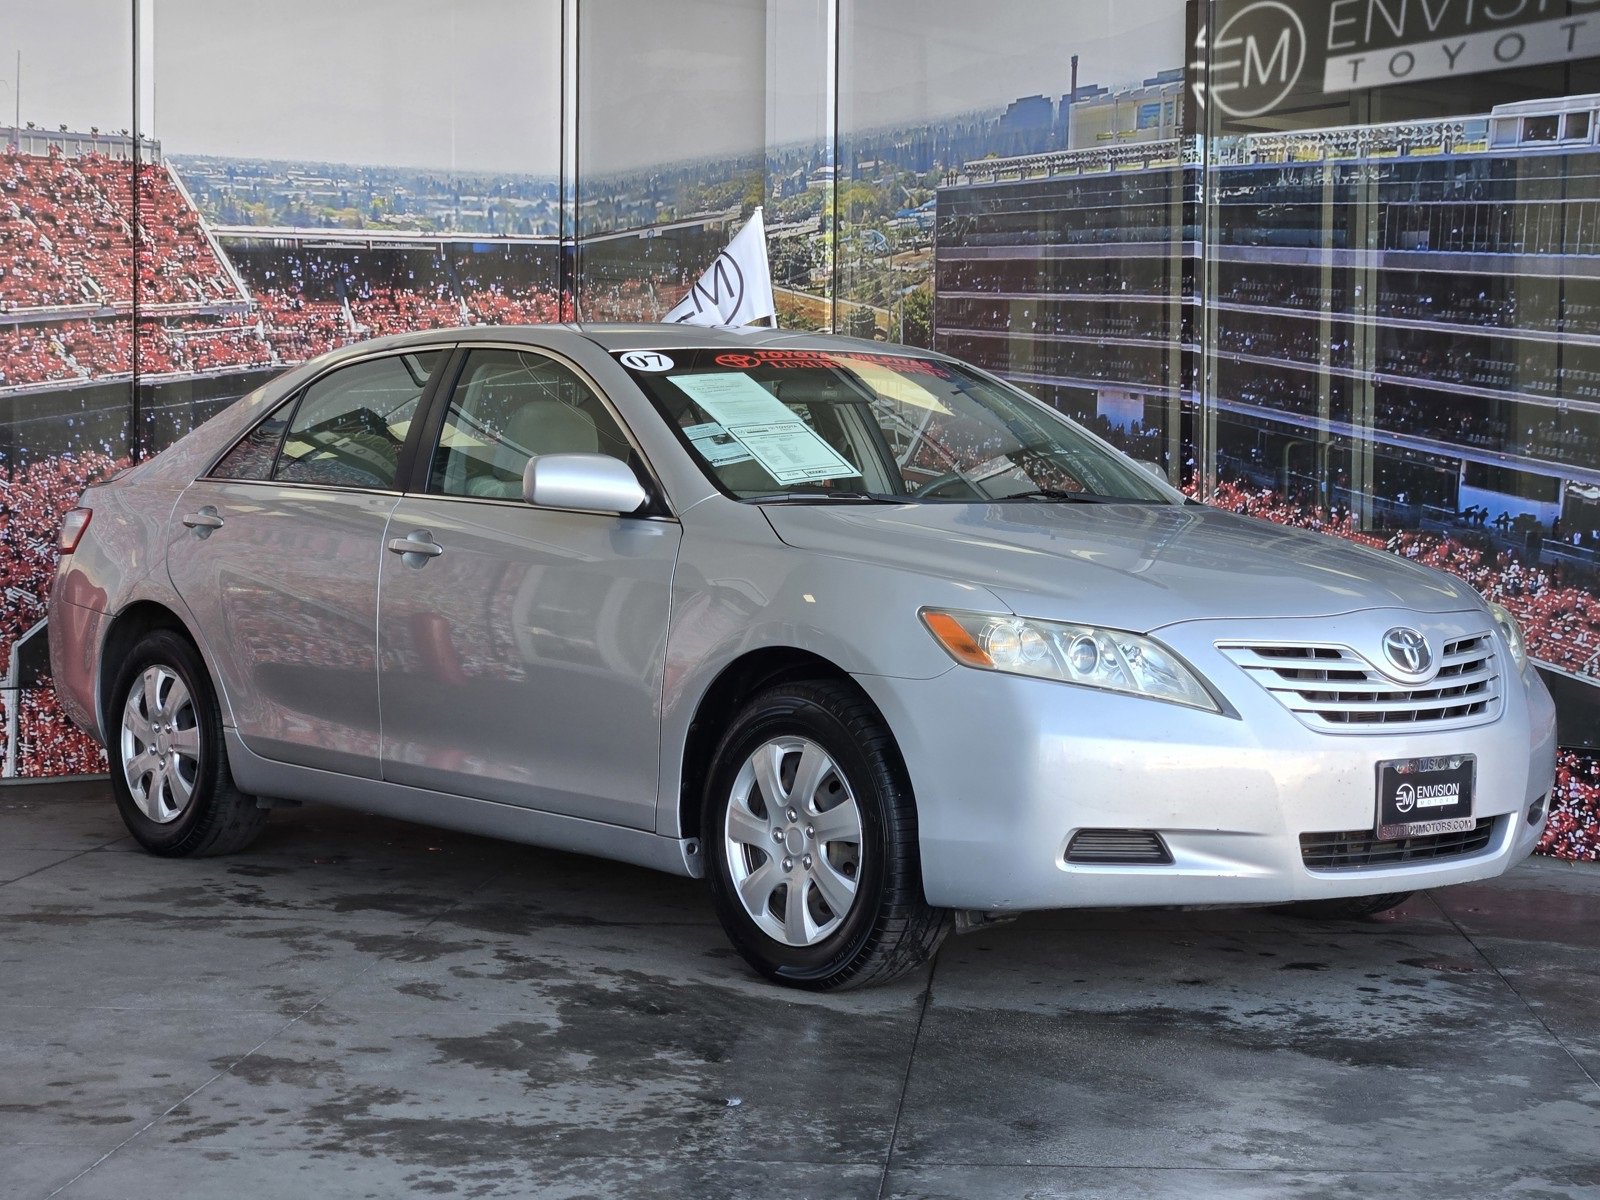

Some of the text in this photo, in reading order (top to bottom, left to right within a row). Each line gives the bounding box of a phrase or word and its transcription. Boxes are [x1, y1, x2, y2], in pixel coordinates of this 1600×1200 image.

[1327, 0, 1600, 50] ENVI
[1348, 21, 1587, 83] TOYOT
[626, 355, 664, 368] 07
[753, 351, 830, 359] TOYOTA
[1416, 783, 1460, 798] ENVISION
